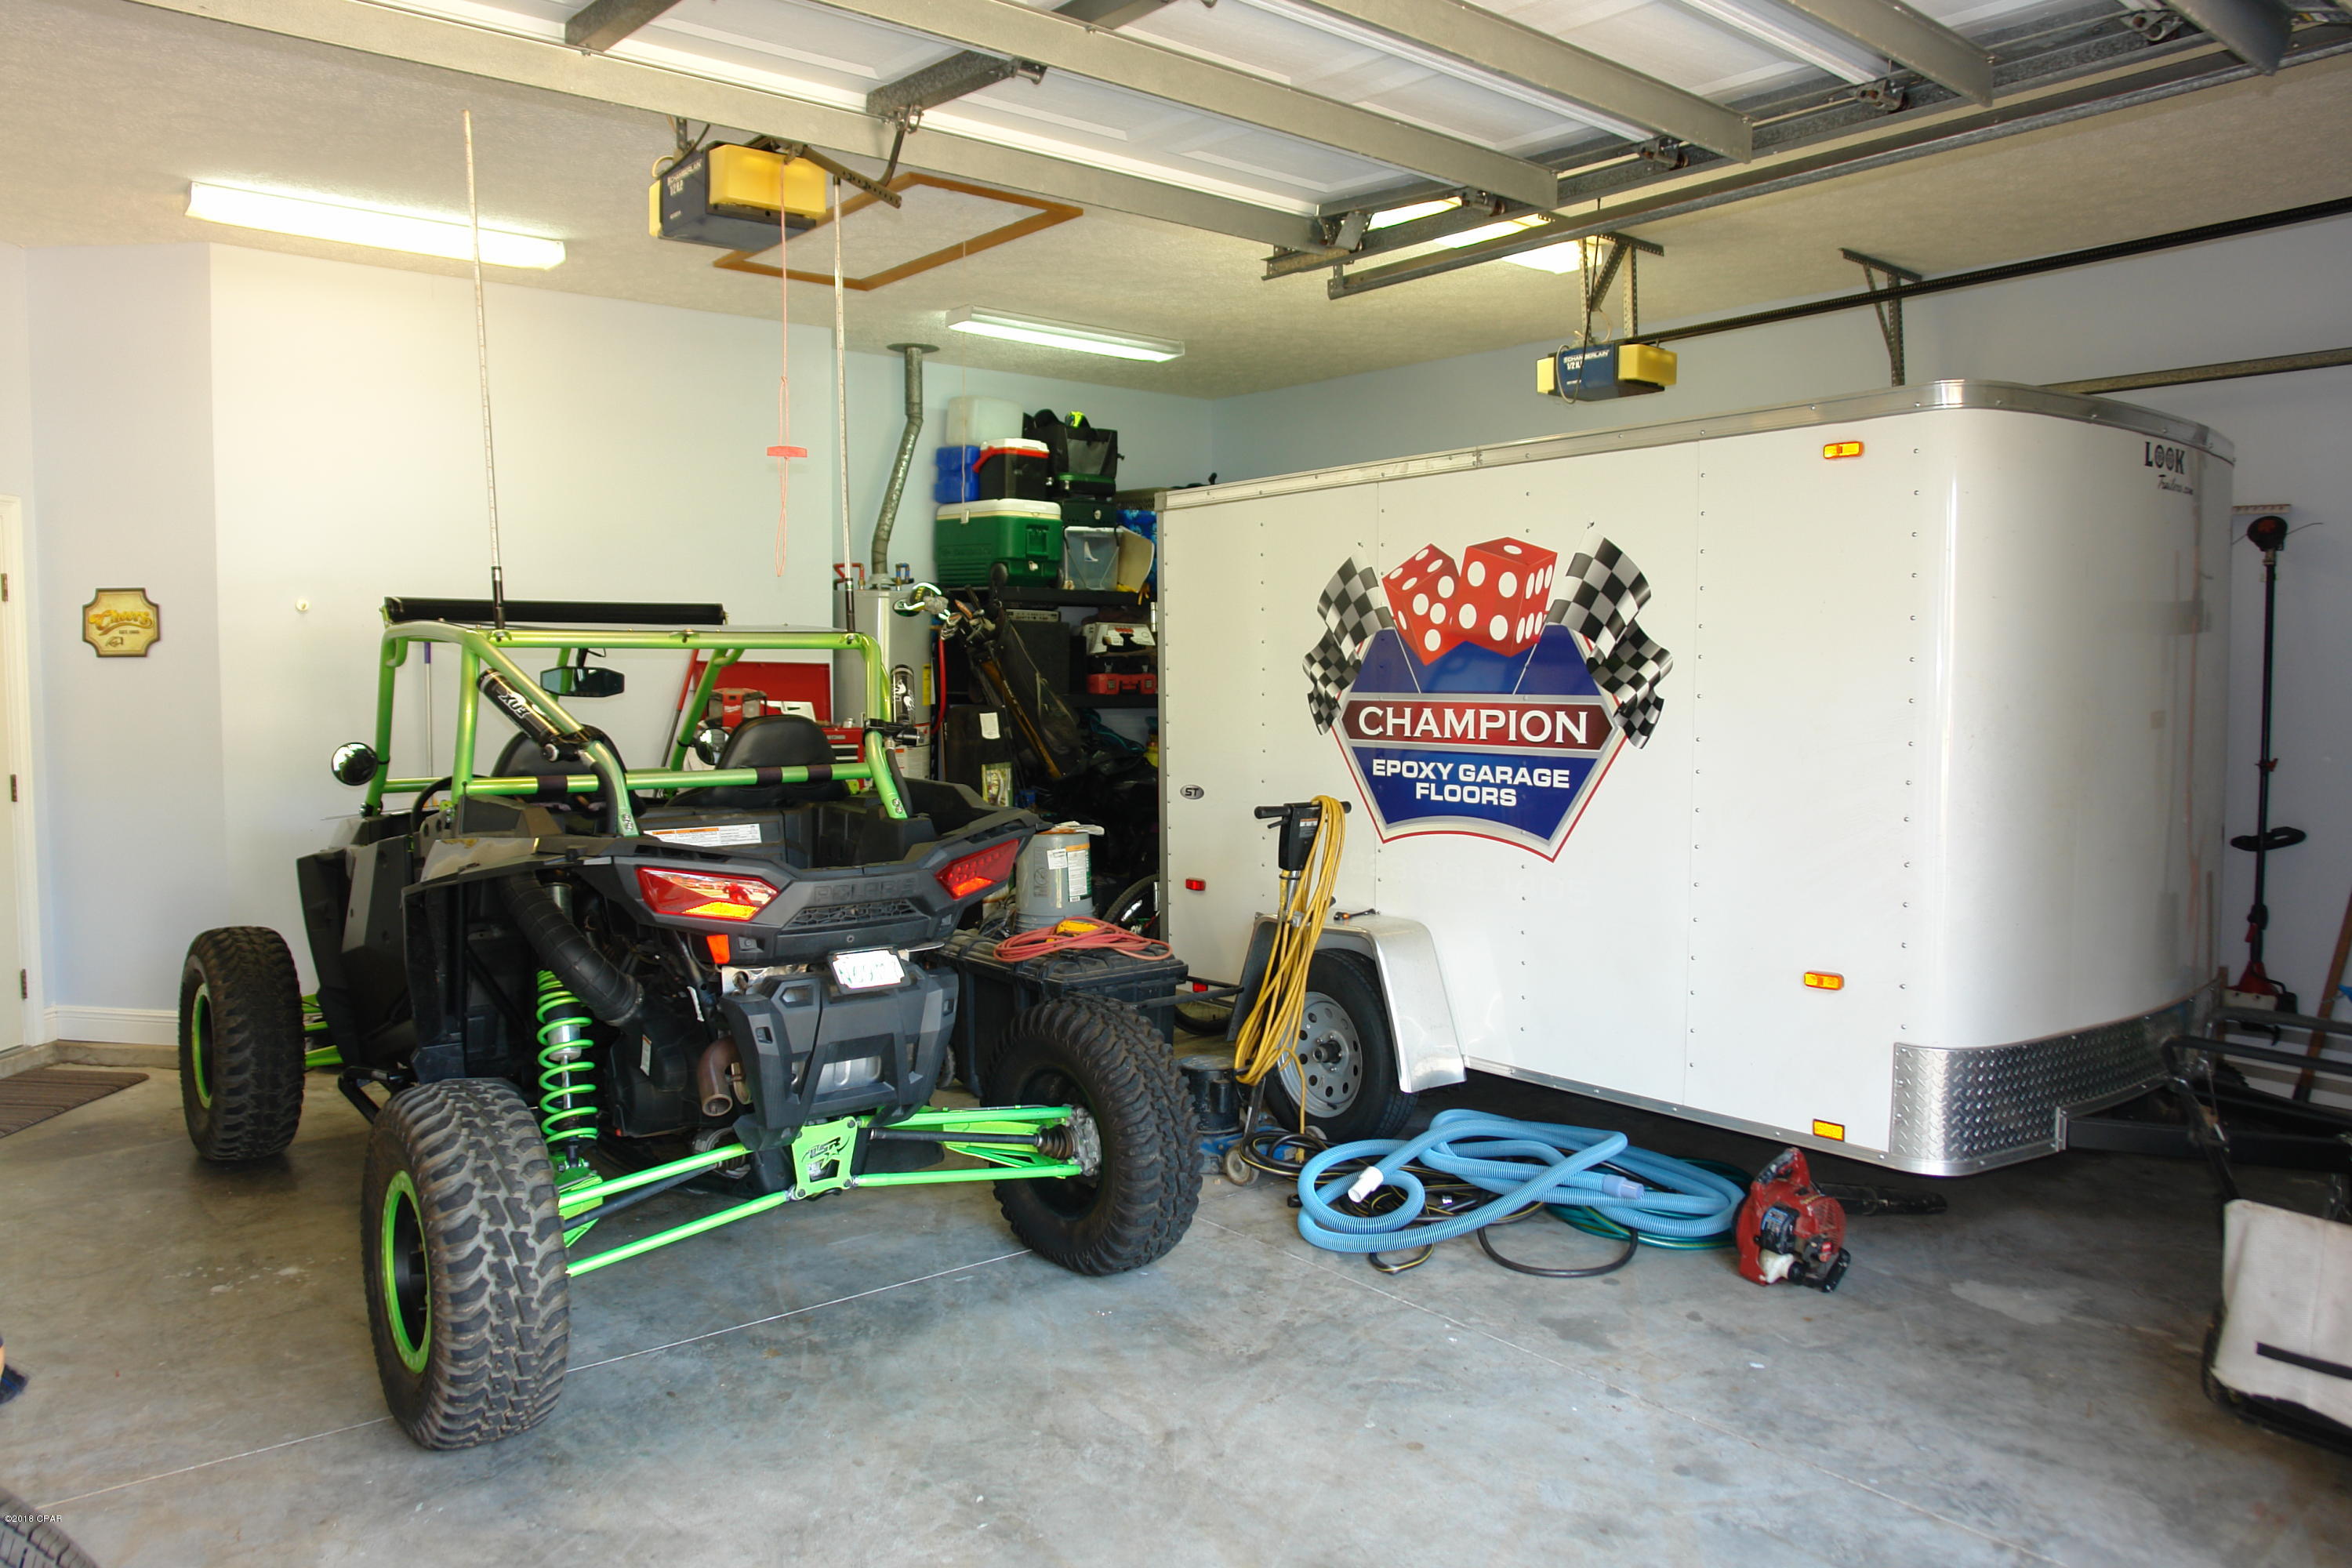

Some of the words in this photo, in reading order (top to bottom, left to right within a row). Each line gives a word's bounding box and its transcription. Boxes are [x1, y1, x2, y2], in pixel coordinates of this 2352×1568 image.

[2144, 441, 2185, 475] LOOK
[497, 691, 532, 719] FOX
[1358, 706, 1588, 744] CHAMPION
[1372, 758, 1454, 781] EPOXY
[1458, 764, 1570, 789] GARAGE
[1185, 786, 1200, 797] ST
[1415, 782, 1517, 807] FLOORS
